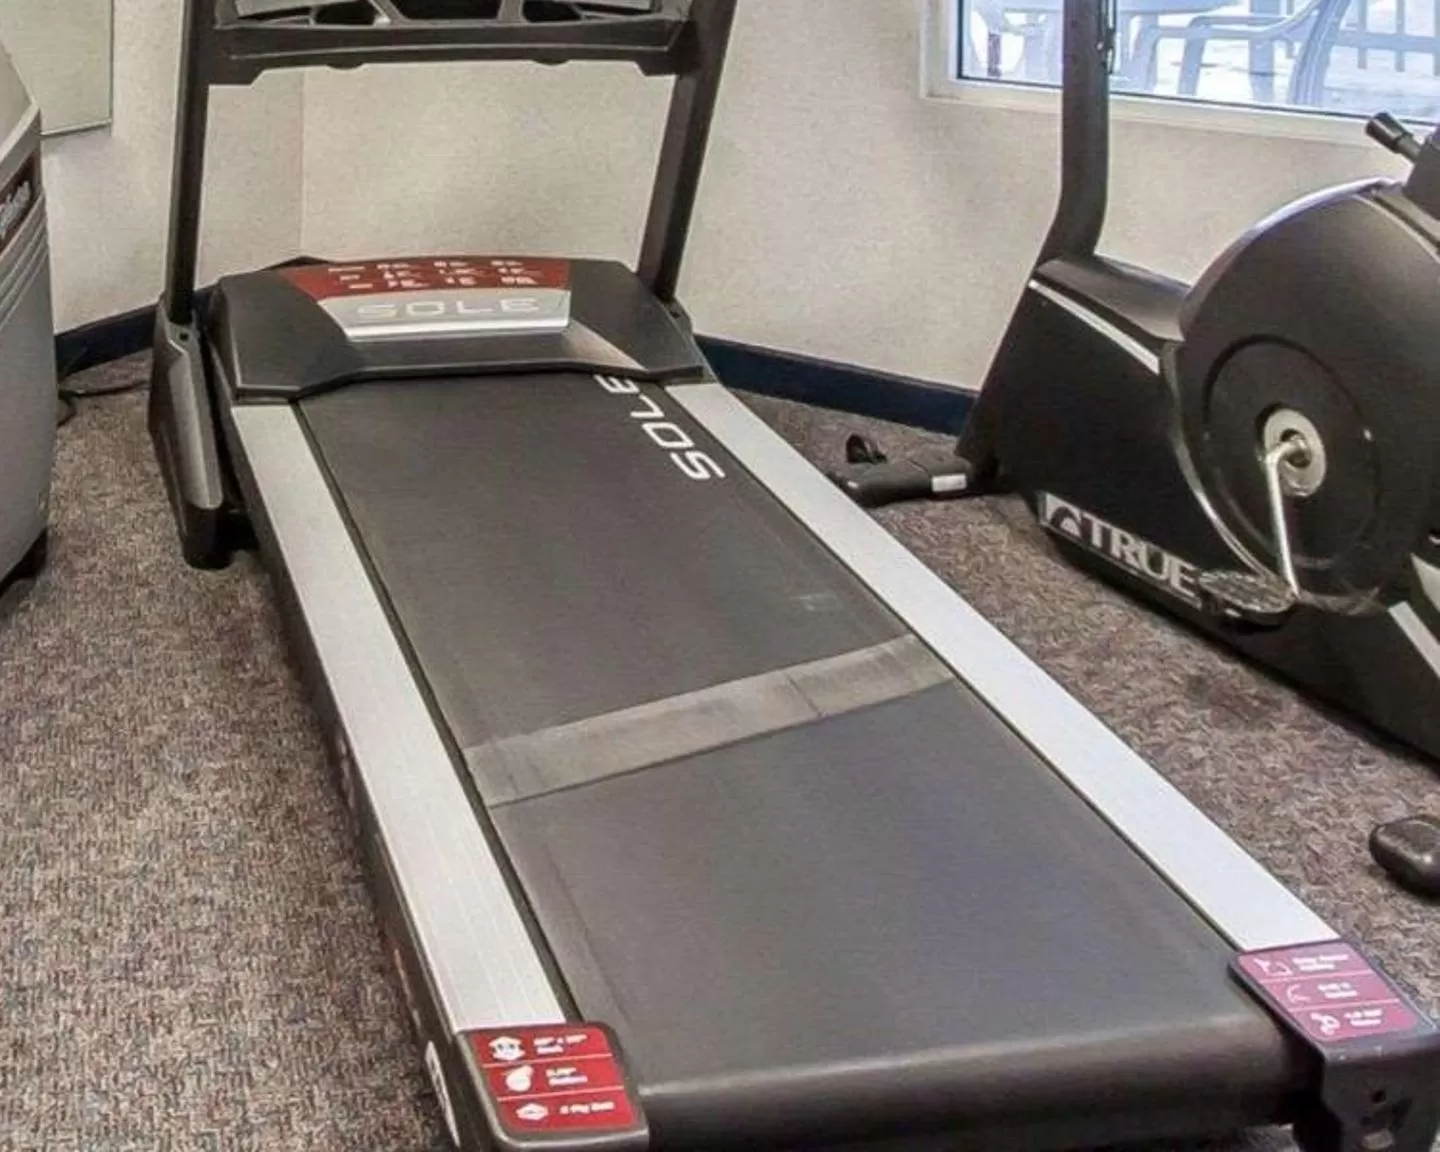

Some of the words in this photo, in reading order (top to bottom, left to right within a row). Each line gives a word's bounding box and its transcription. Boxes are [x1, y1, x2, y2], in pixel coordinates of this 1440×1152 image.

[357, 298, 539, 318] SOLE
[593, 374, 726, 480] SOLE
[1081, 511, 1201, 599] TRUE
